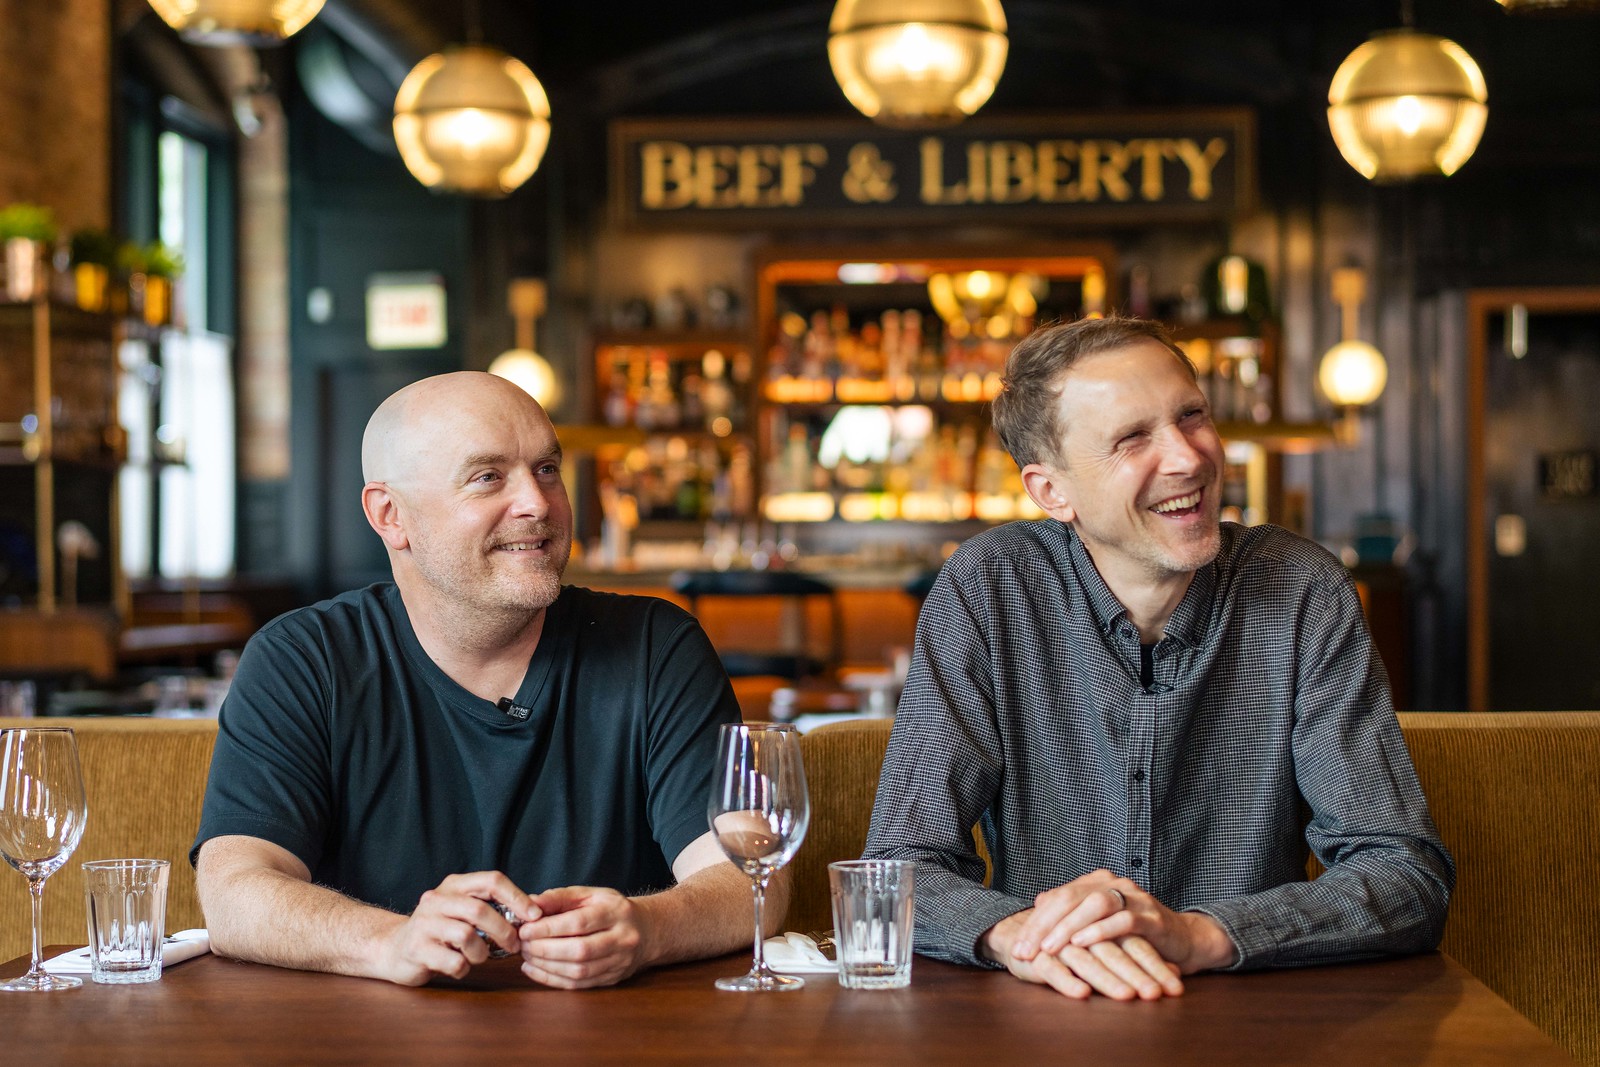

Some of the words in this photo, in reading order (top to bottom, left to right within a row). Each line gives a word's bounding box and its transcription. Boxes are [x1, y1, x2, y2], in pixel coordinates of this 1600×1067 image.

[641, 141, 828, 209] BEEF
[842, 142, 897, 202] &
[920, 137, 1227, 205] LIBERTY
